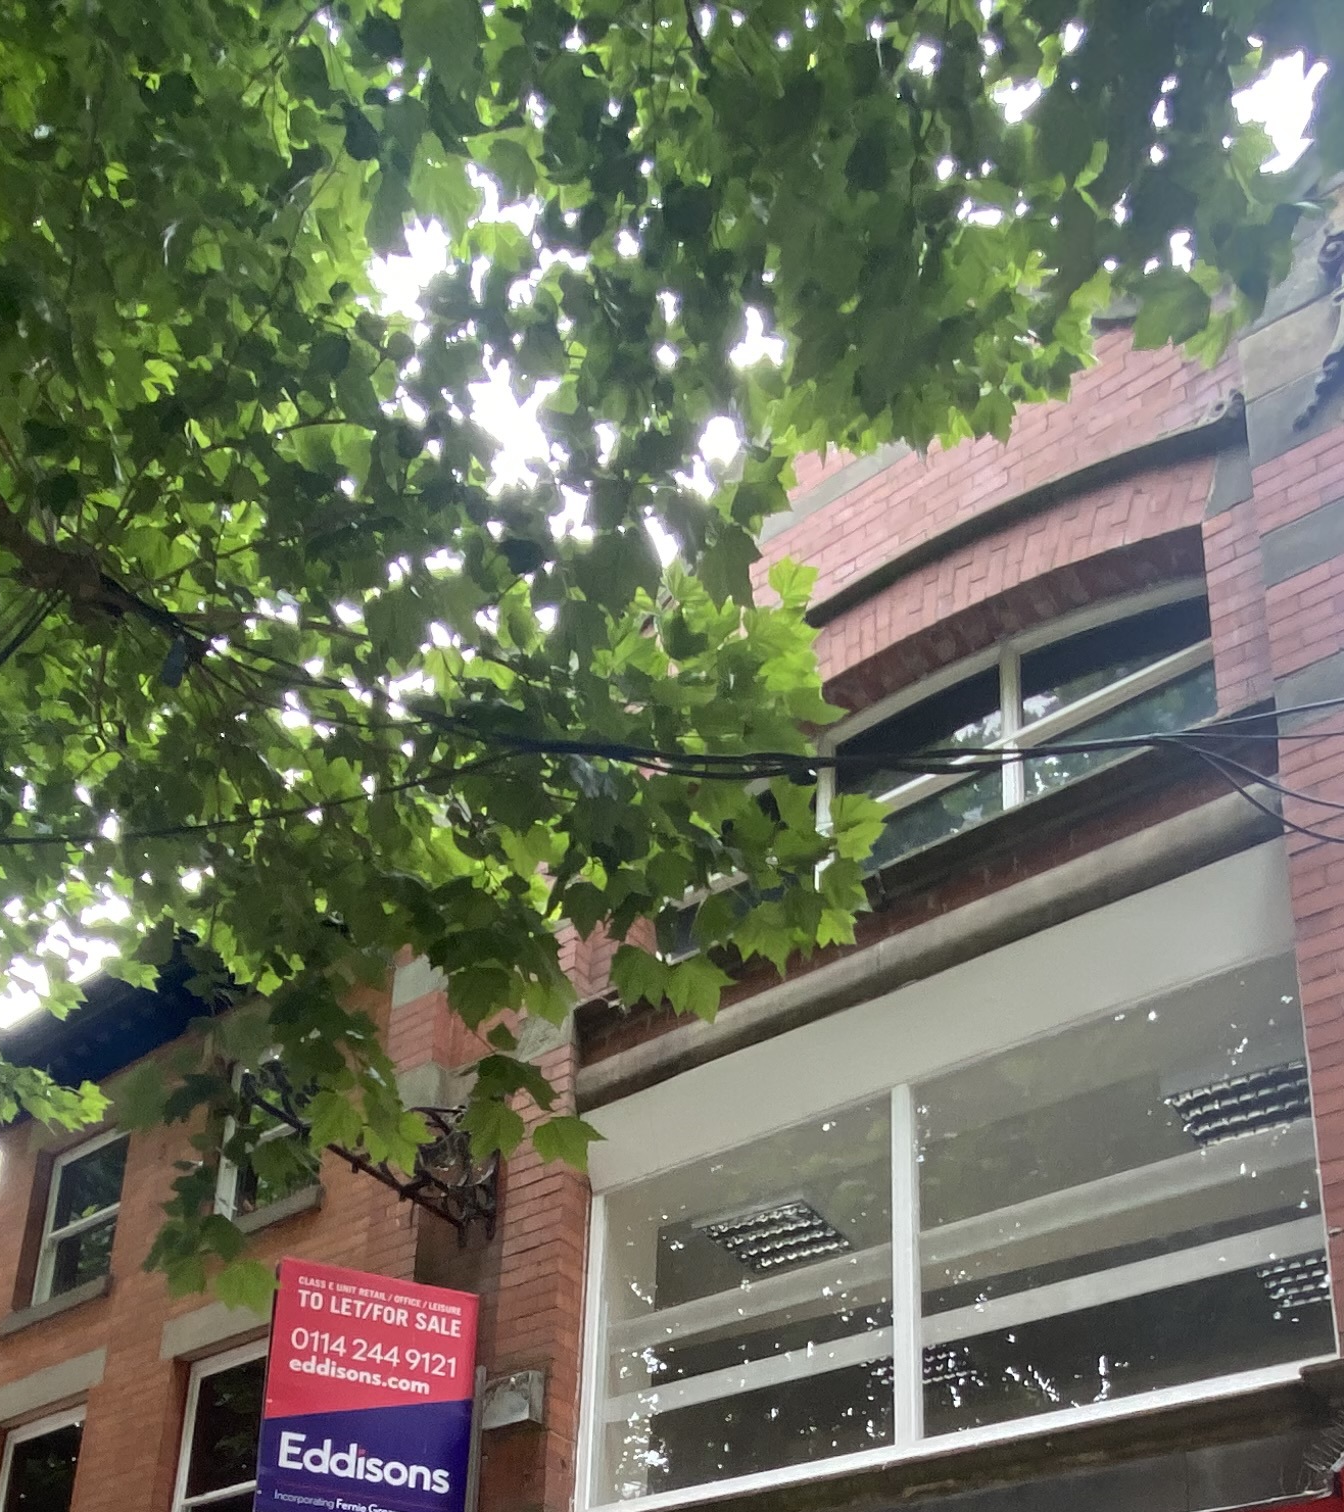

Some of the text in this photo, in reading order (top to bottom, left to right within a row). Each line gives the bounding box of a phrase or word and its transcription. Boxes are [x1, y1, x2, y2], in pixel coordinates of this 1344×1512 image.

[298, 1276, 326, 1289] CLASS
[337, 1283, 357, 1295] UNIT
[358, 1288, 386, 1302] RETAIL
[394, 1295, 421, 1308] OFFICE
[428, 1302, 462, 1316] LEISURE
[298, 1289, 462, 1338] TO LET/FOR SALE
[291, 1327, 457, 1378] 0114 244 9121
[289, 1355, 430, 1395] eddisons.com
[278, 1431, 450, 1494] Eddisons
[274, 1489, 335, 1510] Incorporating
